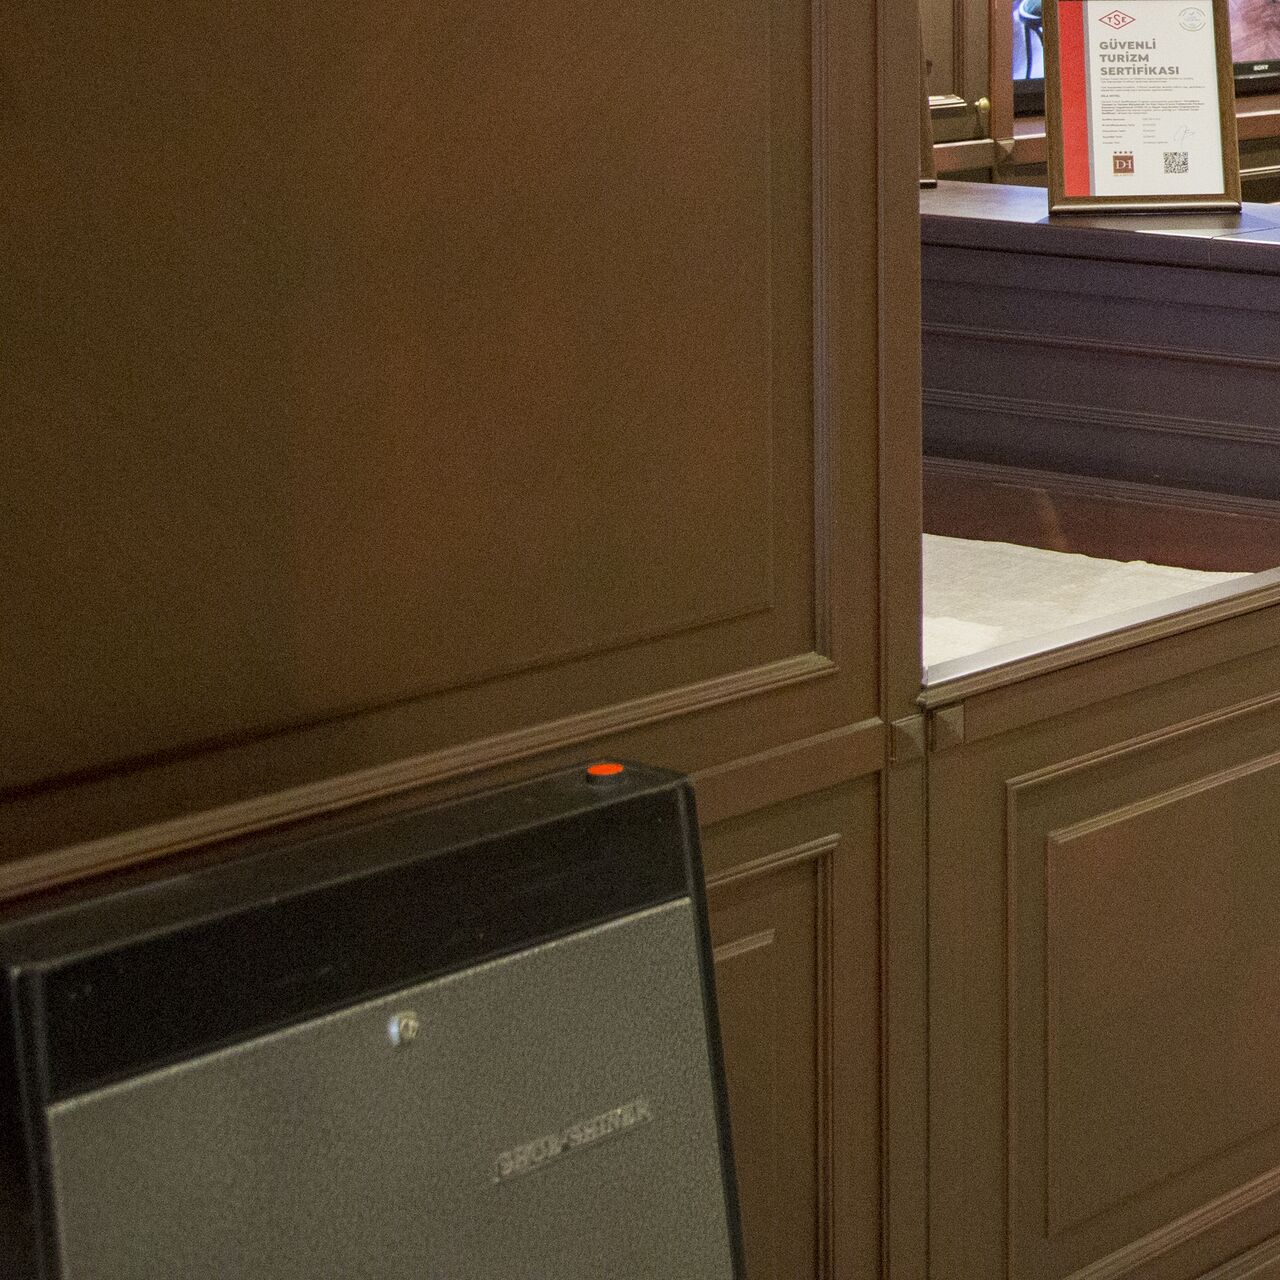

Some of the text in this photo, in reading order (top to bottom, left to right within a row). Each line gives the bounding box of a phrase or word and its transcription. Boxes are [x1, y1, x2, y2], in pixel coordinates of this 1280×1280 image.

[1107, 14, 1127, 26] TSE
[1099, 38, 1156, 50] GÜVENLİ
[1099, 51, 1150, 63] TURİZM
[1100, 64, 1180, 76] SERTİFİKASI
